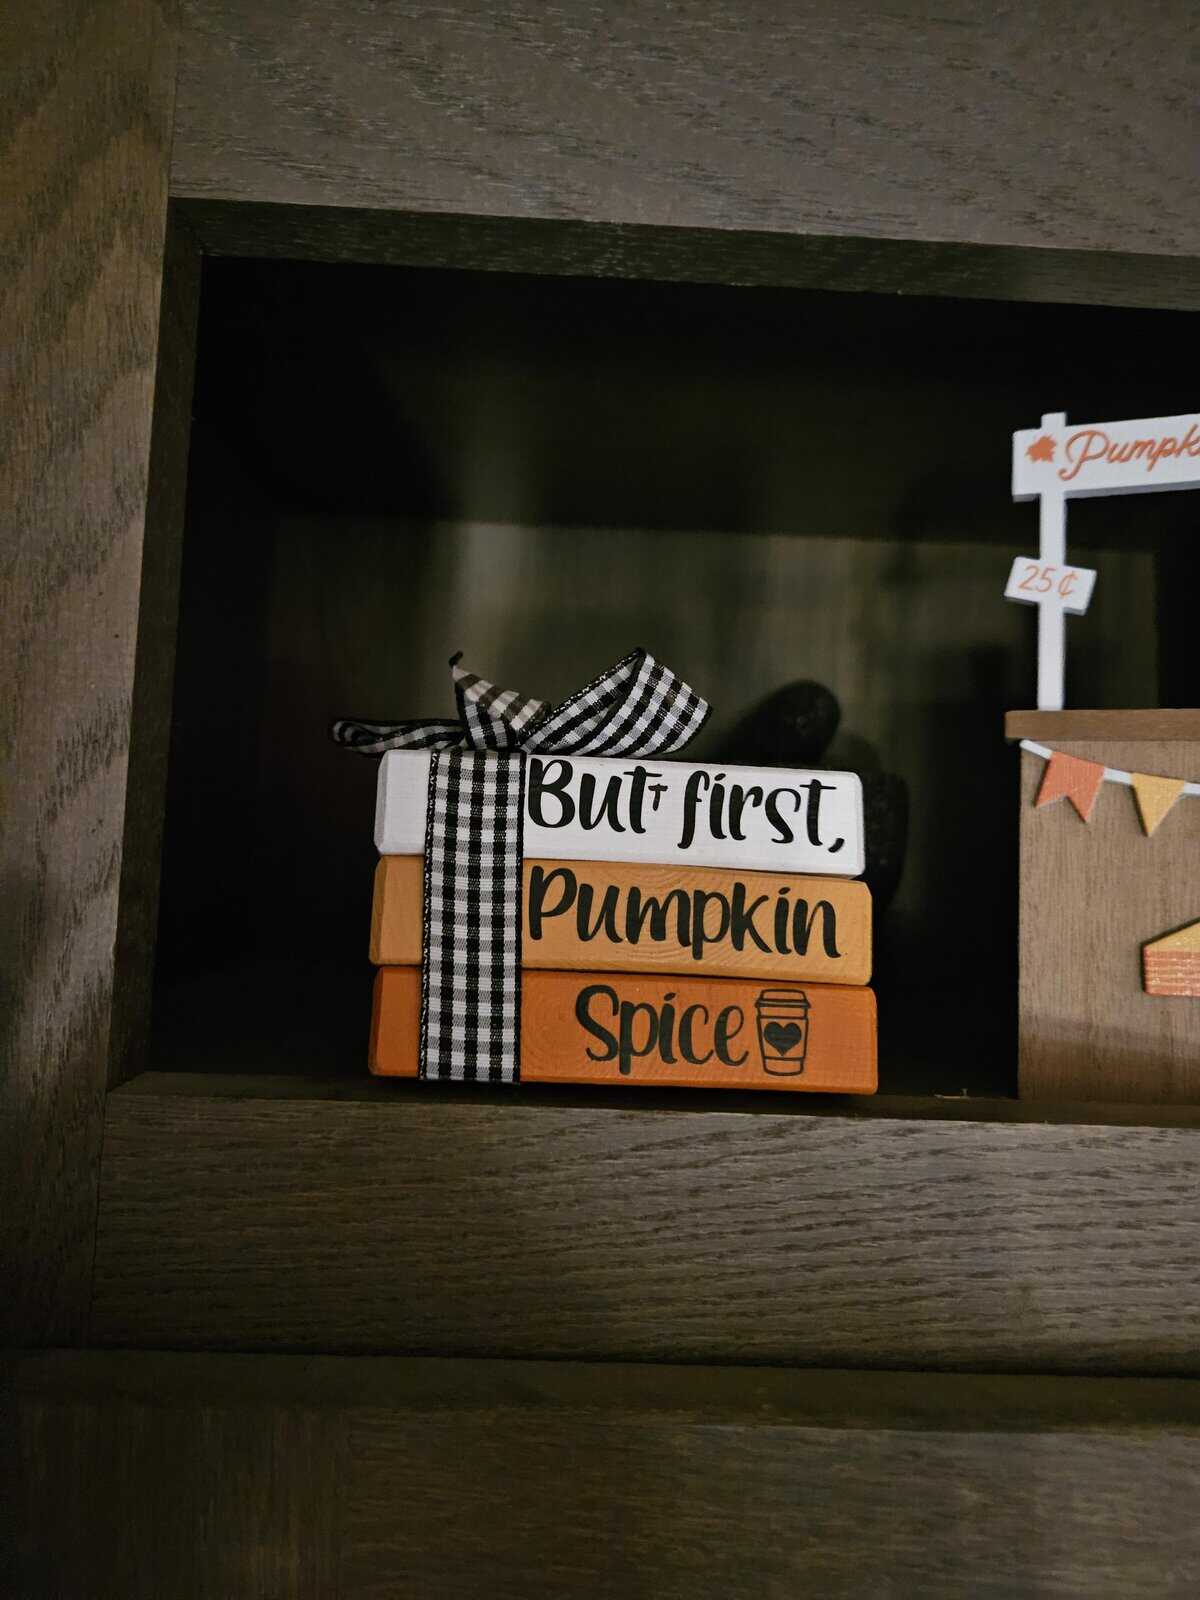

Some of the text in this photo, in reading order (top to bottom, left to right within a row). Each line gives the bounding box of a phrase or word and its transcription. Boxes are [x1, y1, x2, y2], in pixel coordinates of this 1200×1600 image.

[1018, 564, 1078, 597] 25¢
[677, 770, 845, 853] first,
[528, 865, 841, 961] Pumpkin
[575, 984, 749, 1075] Spice
